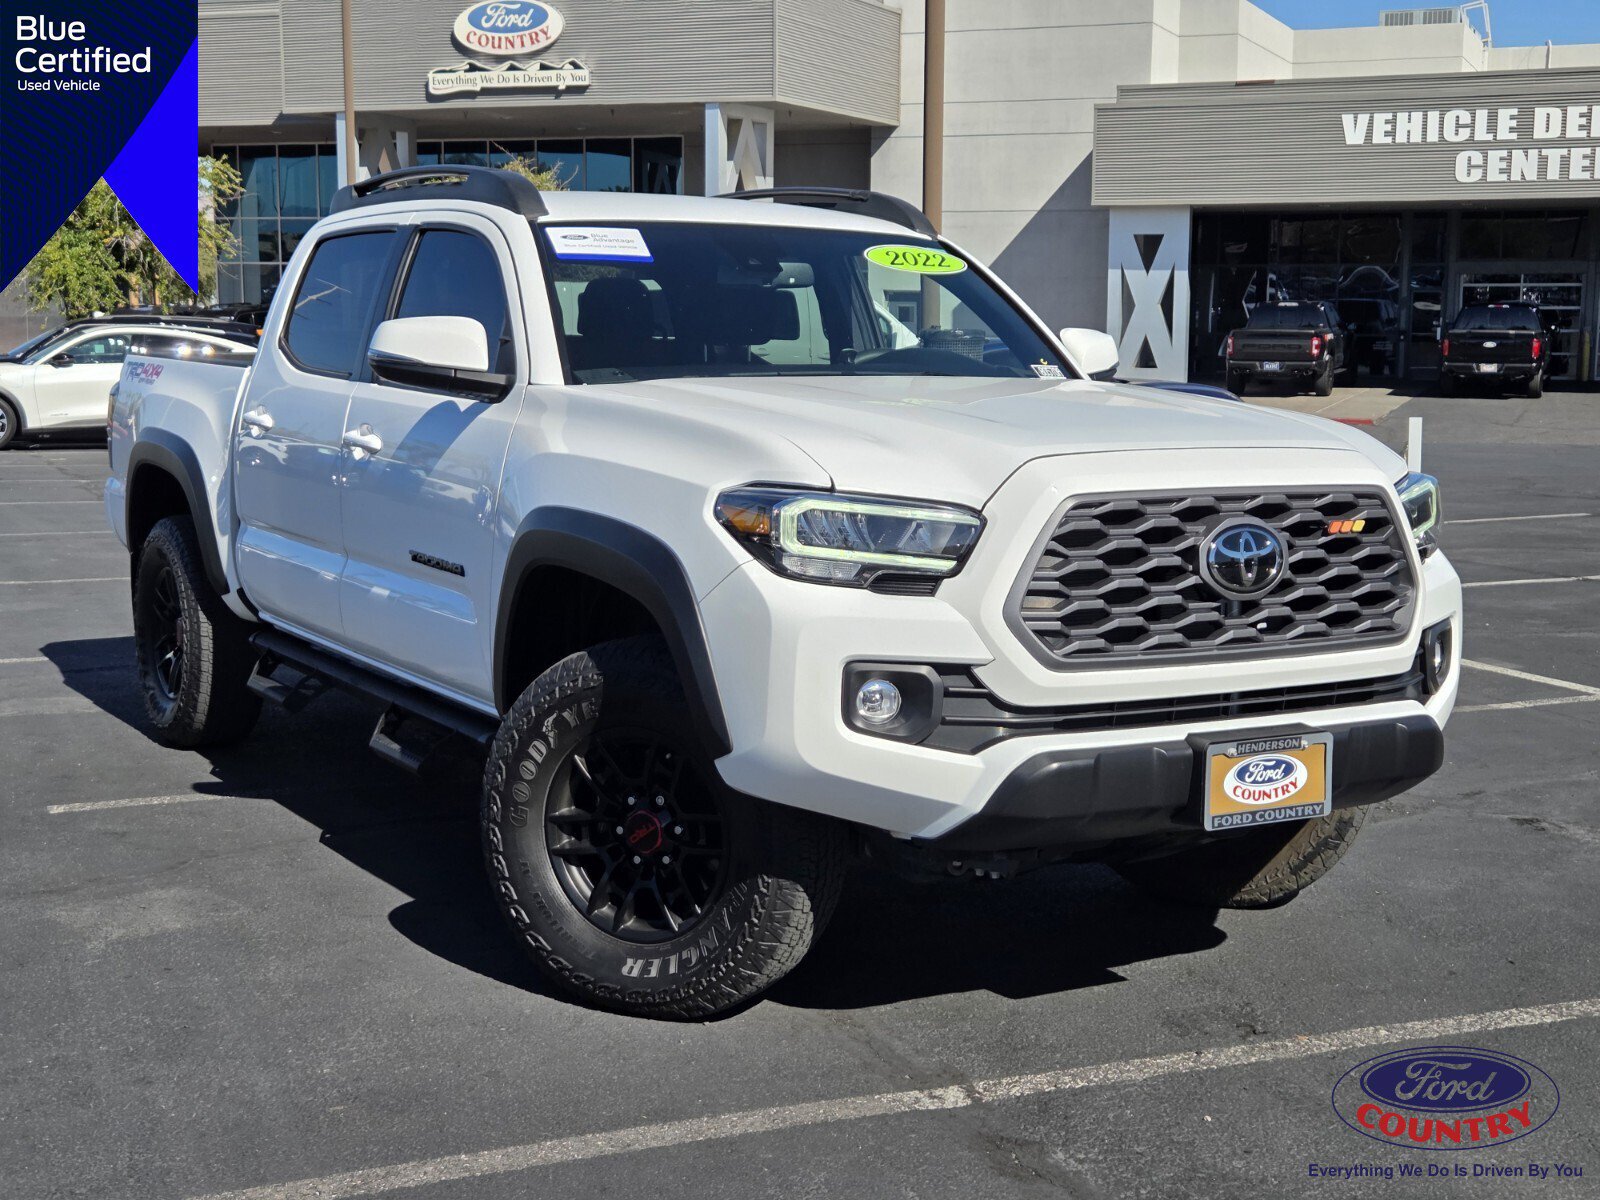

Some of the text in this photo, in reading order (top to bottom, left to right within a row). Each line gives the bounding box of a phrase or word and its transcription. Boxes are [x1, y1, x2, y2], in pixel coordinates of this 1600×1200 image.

[481, 2, 535, 28] Ford
[466, 26, 552, 50] COUNTRY
[432, 73, 587, 87] Everything We Do Is Driven By You
[1341, 108, 1519, 145] VEHICLE
[885, 250, 951, 268] 2022
[1237, 738, 1301, 754] HENDERSON
[1245, 760, 1286, 783] Ford
[1233, 777, 1299, 802] COUNTRY
[1213, 804, 1323, 828] FORD COUNTRY
